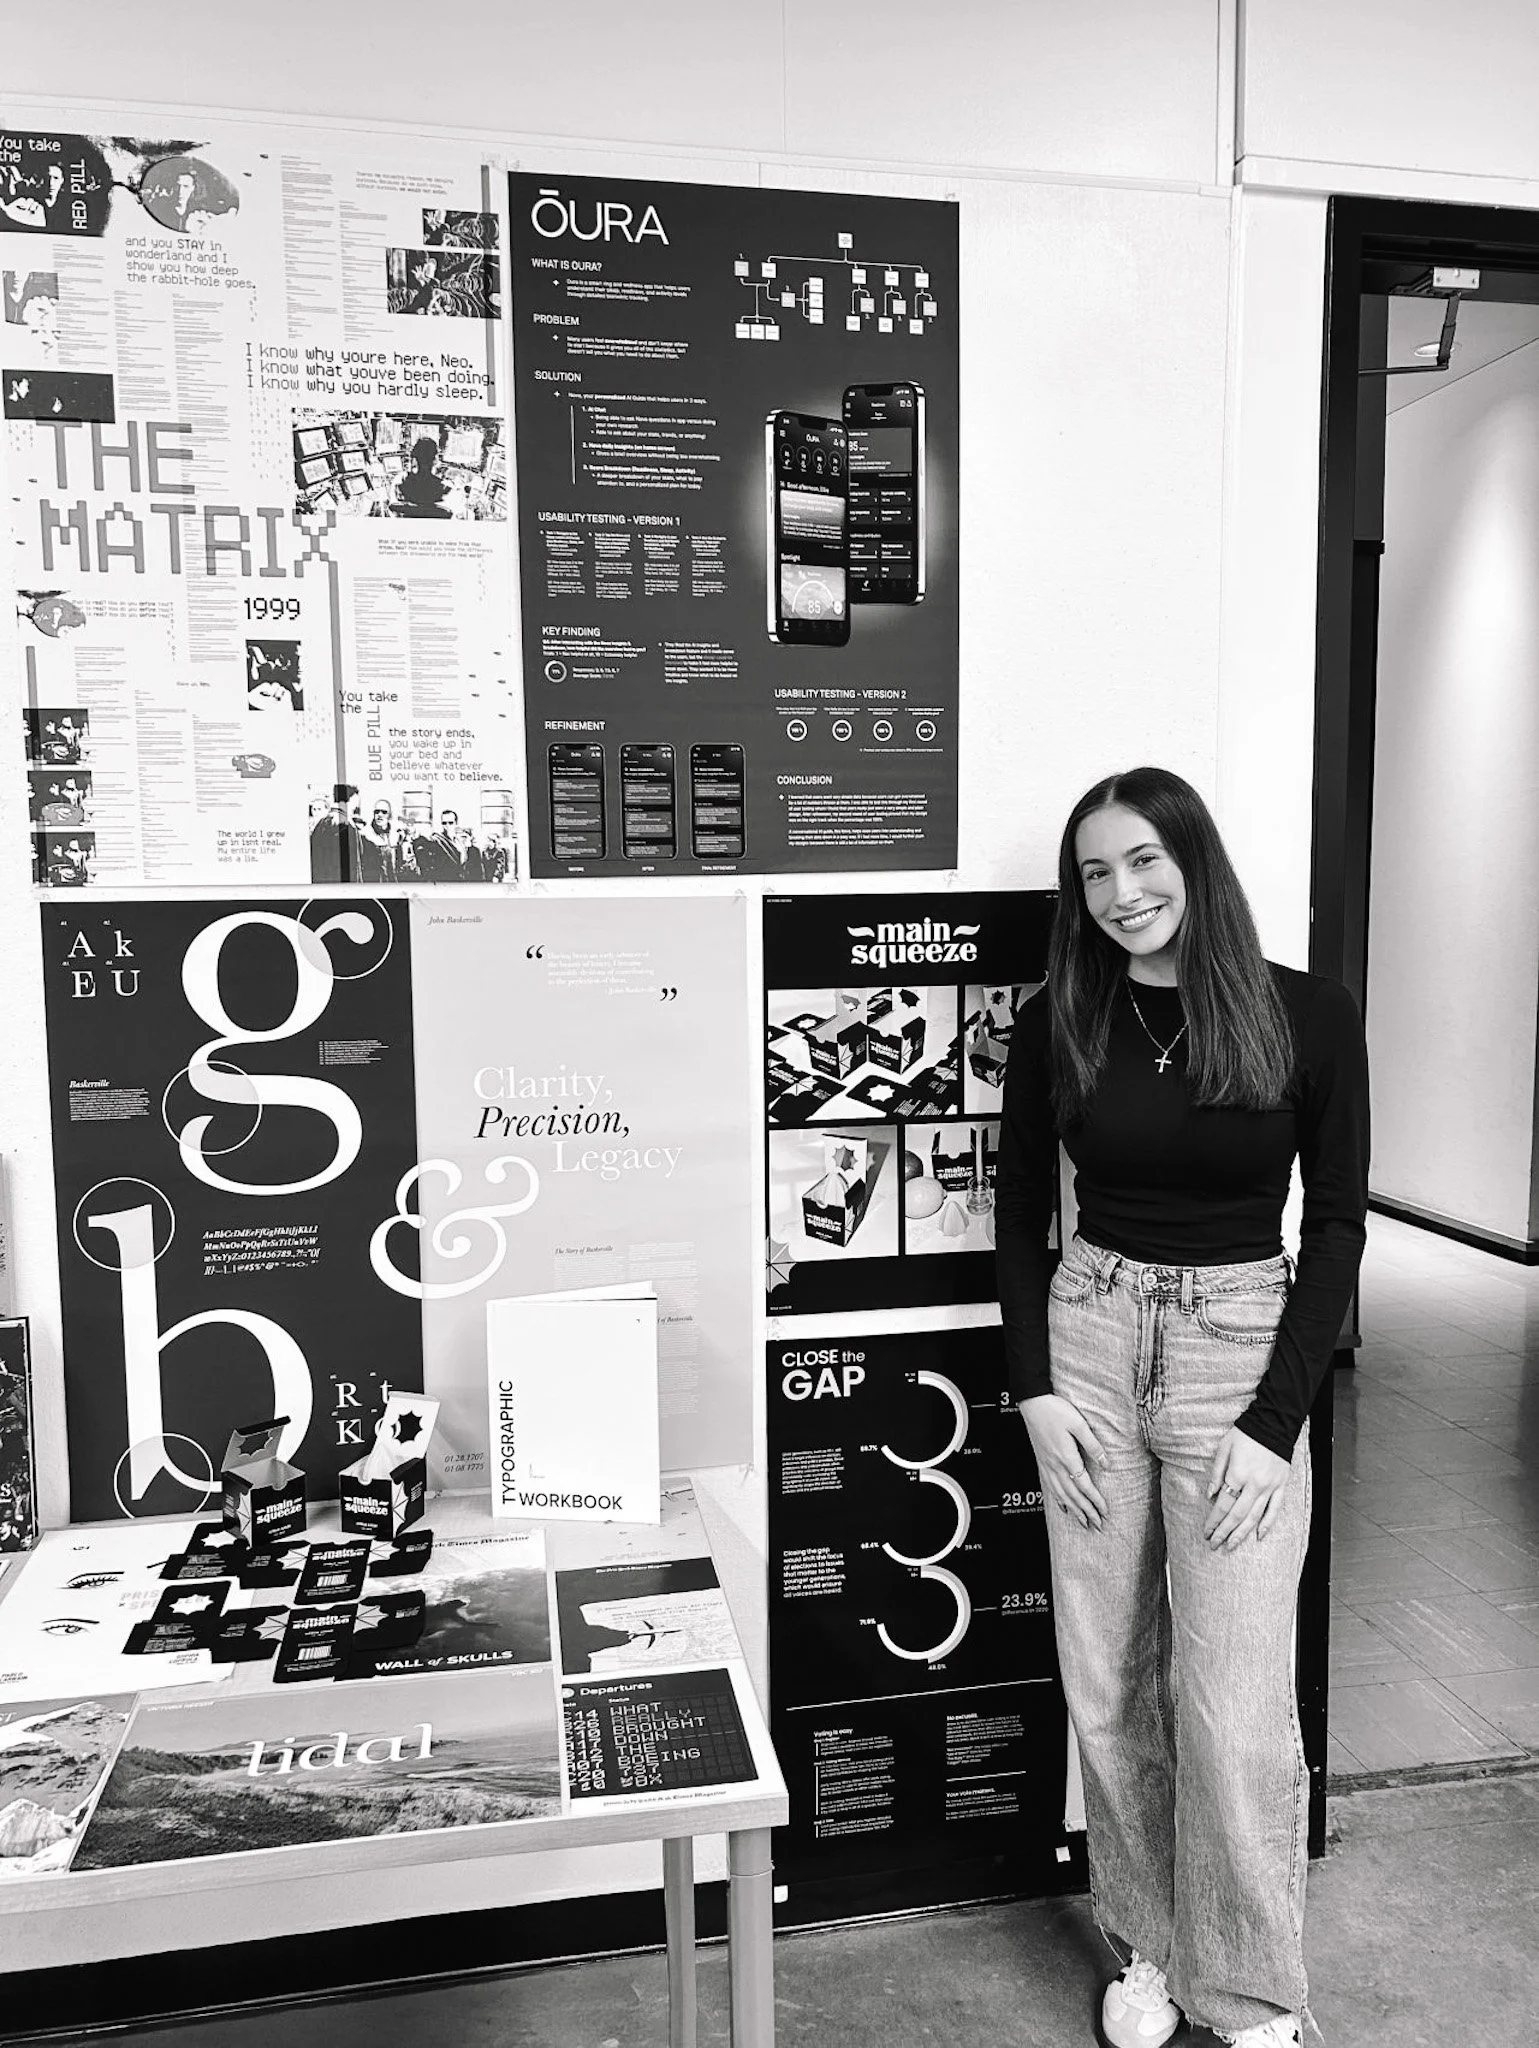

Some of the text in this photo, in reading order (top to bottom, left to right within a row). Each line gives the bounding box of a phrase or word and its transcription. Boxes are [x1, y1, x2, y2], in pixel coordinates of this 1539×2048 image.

[28, 138, 61, 152] take
[70, 159, 88, 230] RED PILL
[125, 237, 222, 251] and you STAY in
[126, 248, 227, 263] wonderland and I
[126, 261, 239, 276] show you how deep
[531, 258, 603, 272] WHAT IS OURA?
[127, 273, 256, 290] the rabbit-hole goes.
[533, 313, 580, 326] PROBLEM
[246, 342, 473, 369] I know why youre here, Neo.
[247, 359, 495, 387] I know what youve been doing.
[535, 370, 582, 382] SOLUTION
[247, 374, 484, 401] I know why you hardly sleep.
[35, 418, 196, 494] THE
[538, 512, 586, 523] USABILITY
[586, 513, 626, 525] TESTING
[634, 515, 671, 526] VERSION
[675, 517, 681, 526] 1
[40, 499, 338, 579] MATRIX
[245, 597, 301, 620] 1999
[542, 626, 601, 637] KEY FINDING
[339, 690, 398, 702] You take
[774, 689, 820, 699] USABILITY
[820, 689, 855, 699] TESTING
[862, 690, 900, 700] VERSION
[901, 691, 907, 700] 2
[340, 703, 362, 714] the
[389, 728, 475, 739] the story ends,
[545, 720, 606, 731] REFINEMENT
[367, 705, 383, 781] BLUE PILL
[389, 739, 472, 750] you wake up in
[389, 750, 462, 760] your bed and
[390, 760, 483, 771] believe whatever
[390, 771, 503, 782] you want to believe.
[777, 775, 833, 785] CONCLUSION
[218, 830, 231, 838] The
[235, 830, 257, 838] world
[267, 832, 285, 840] grew
[877, 917, 951, 943] main
[67, 930, 135, 958] A k
[851, 942, 977, 968] squeeze
[71, 969, 141, 998] E U
[179, 911, 375, 1196] g
[69, 1079, 110, 1089] Baskerville
[473, 1064, 613, 1106] Clarity,
[473, 1104, 630, 1138] Precision,
[552, 1141, 683, 1181] Legacy
[370, 1156, 540, 1300] &
[782, 1349, 865, 1368] CLOSE the
[781, 1366, 866, 1401] GAP
[335, 1382, 363, 1408] R
[336, 1418, 366, 1445] K
[499, 1380, 516, 1504] TYPOGRAPHIC
[266, 1499, 294, 1513] main
[344, 1502, 389, 1516] squeeze
[353, 1497, 379, 1507] main
[519, 1492, 622, 1510] WORKBOOK
[256, 1504, 302, 1524] squeeze
[1001, 1592, 1048, 1608] 23.9%
[375, 1659, 424, 1671] WALL
[447, 1650, 513, 1664] SKULLS
[580, 1682, 653, 1696] Departures
[610, 1702, 661, 1716] WHAT
[613, 1716, 706, 1735] BROUGHT
[614, 1730, 669, 1746] DOWN
[245, 1721, 435, 1777] tidal
[615, 1742, 657, 1756] THE
[617, 1747, 701, 1766] BOEING
